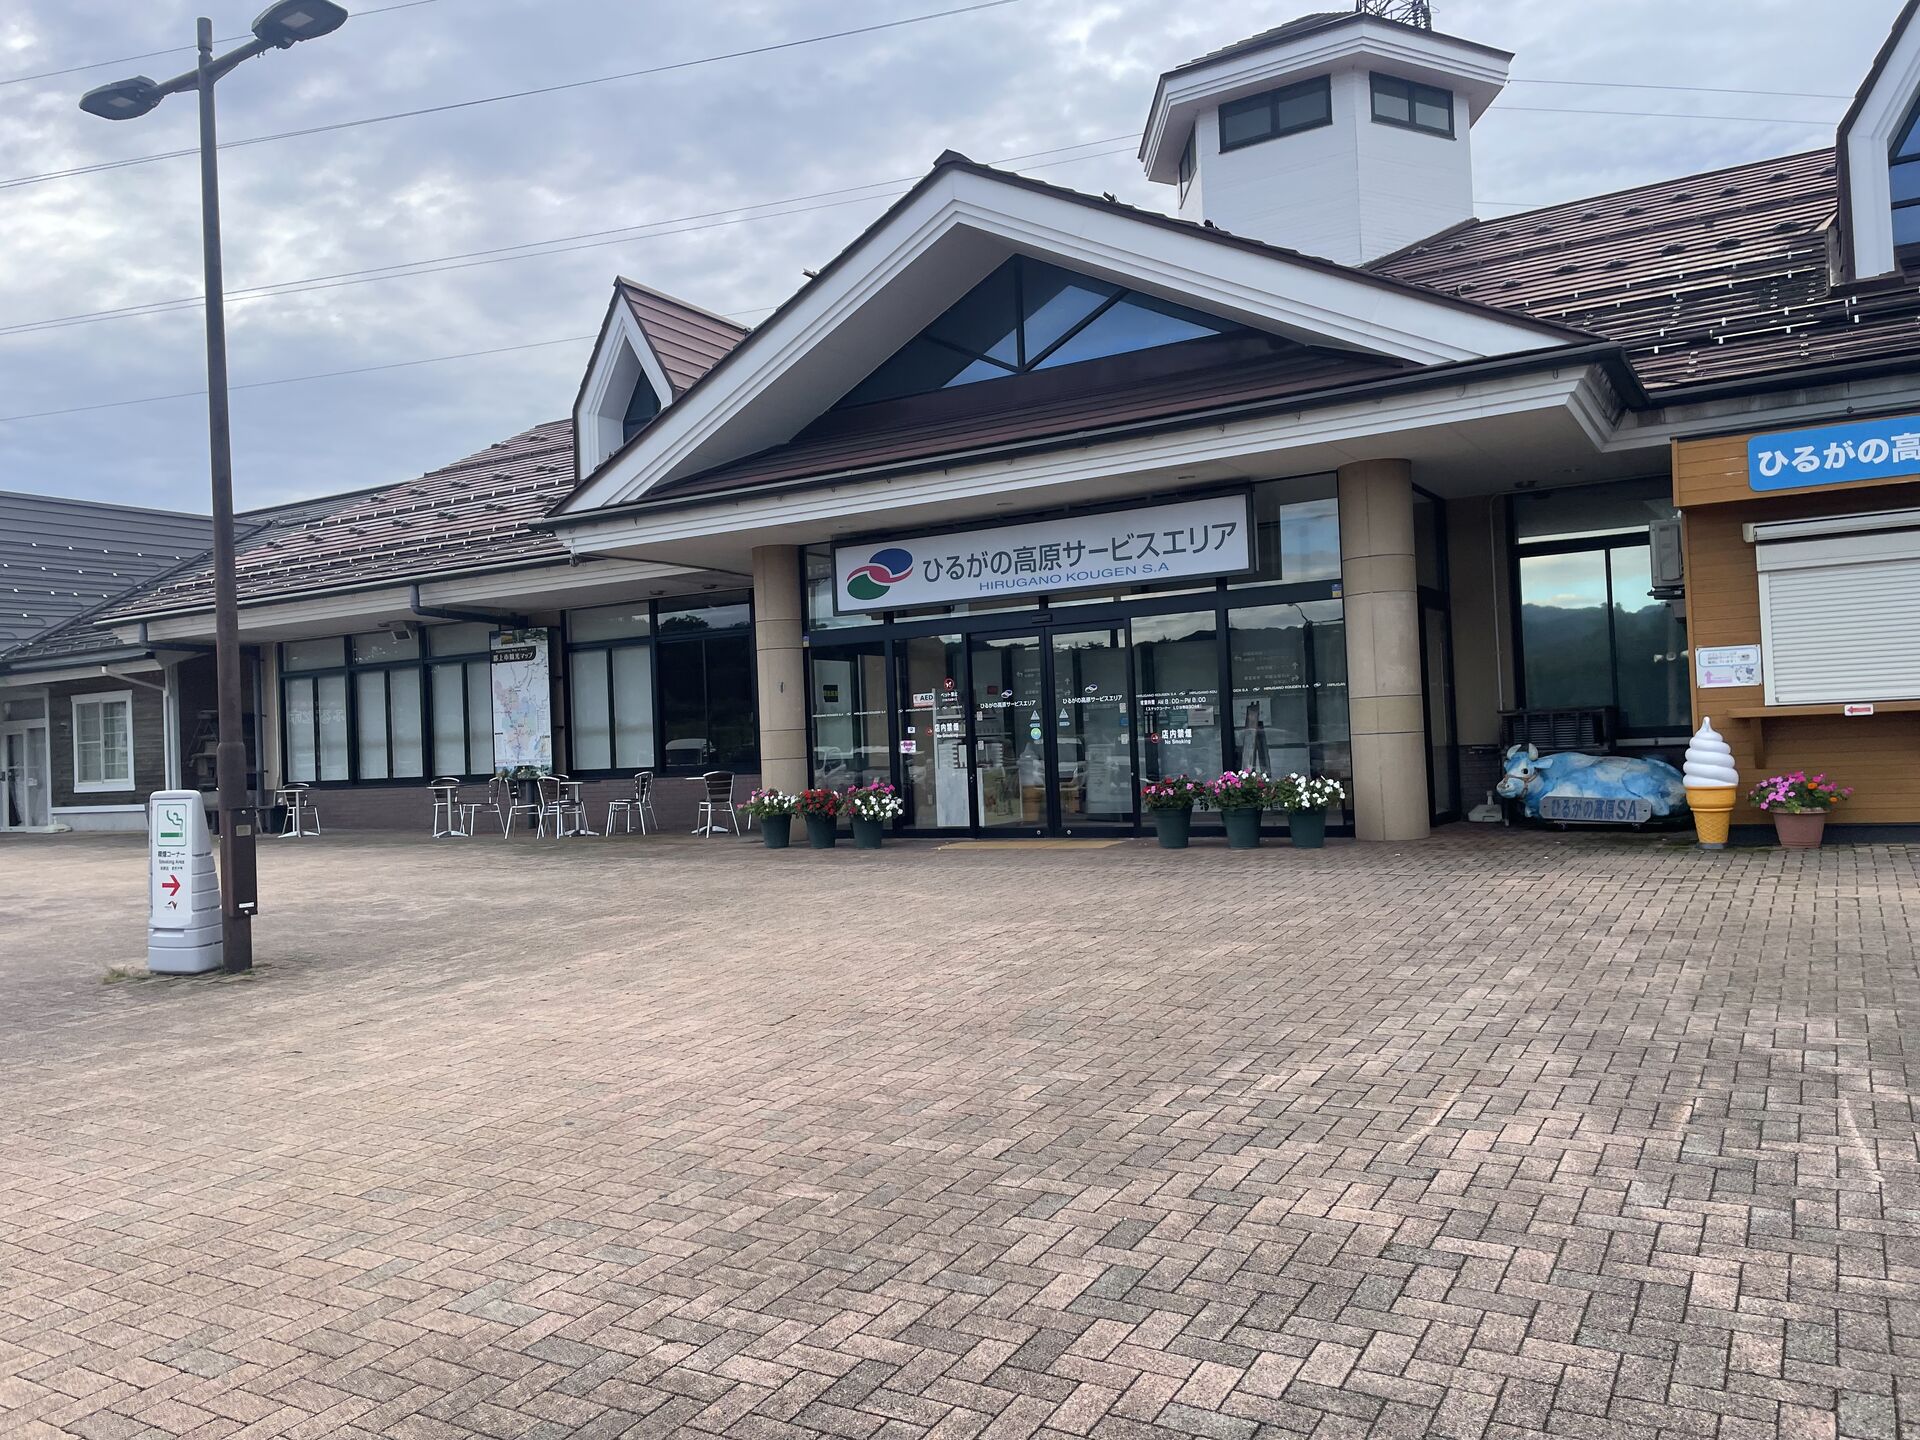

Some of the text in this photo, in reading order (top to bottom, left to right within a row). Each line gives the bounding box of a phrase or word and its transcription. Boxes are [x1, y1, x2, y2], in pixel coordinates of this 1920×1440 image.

[1758, 432, 1920, 477] ひるがの高
[922, 522, 1237, 583] ひるがの高原サービスエリア
[979, 562, 1170, 591] HIRUGANO KOUGEN S.A
[980, 699, 1036, 709] ひるがの高原サービスエリア
[1062, 694, 1123, 705] ひるがの高原サービスエリア
[1161, 728, 1192, 739] 店内禁煙
